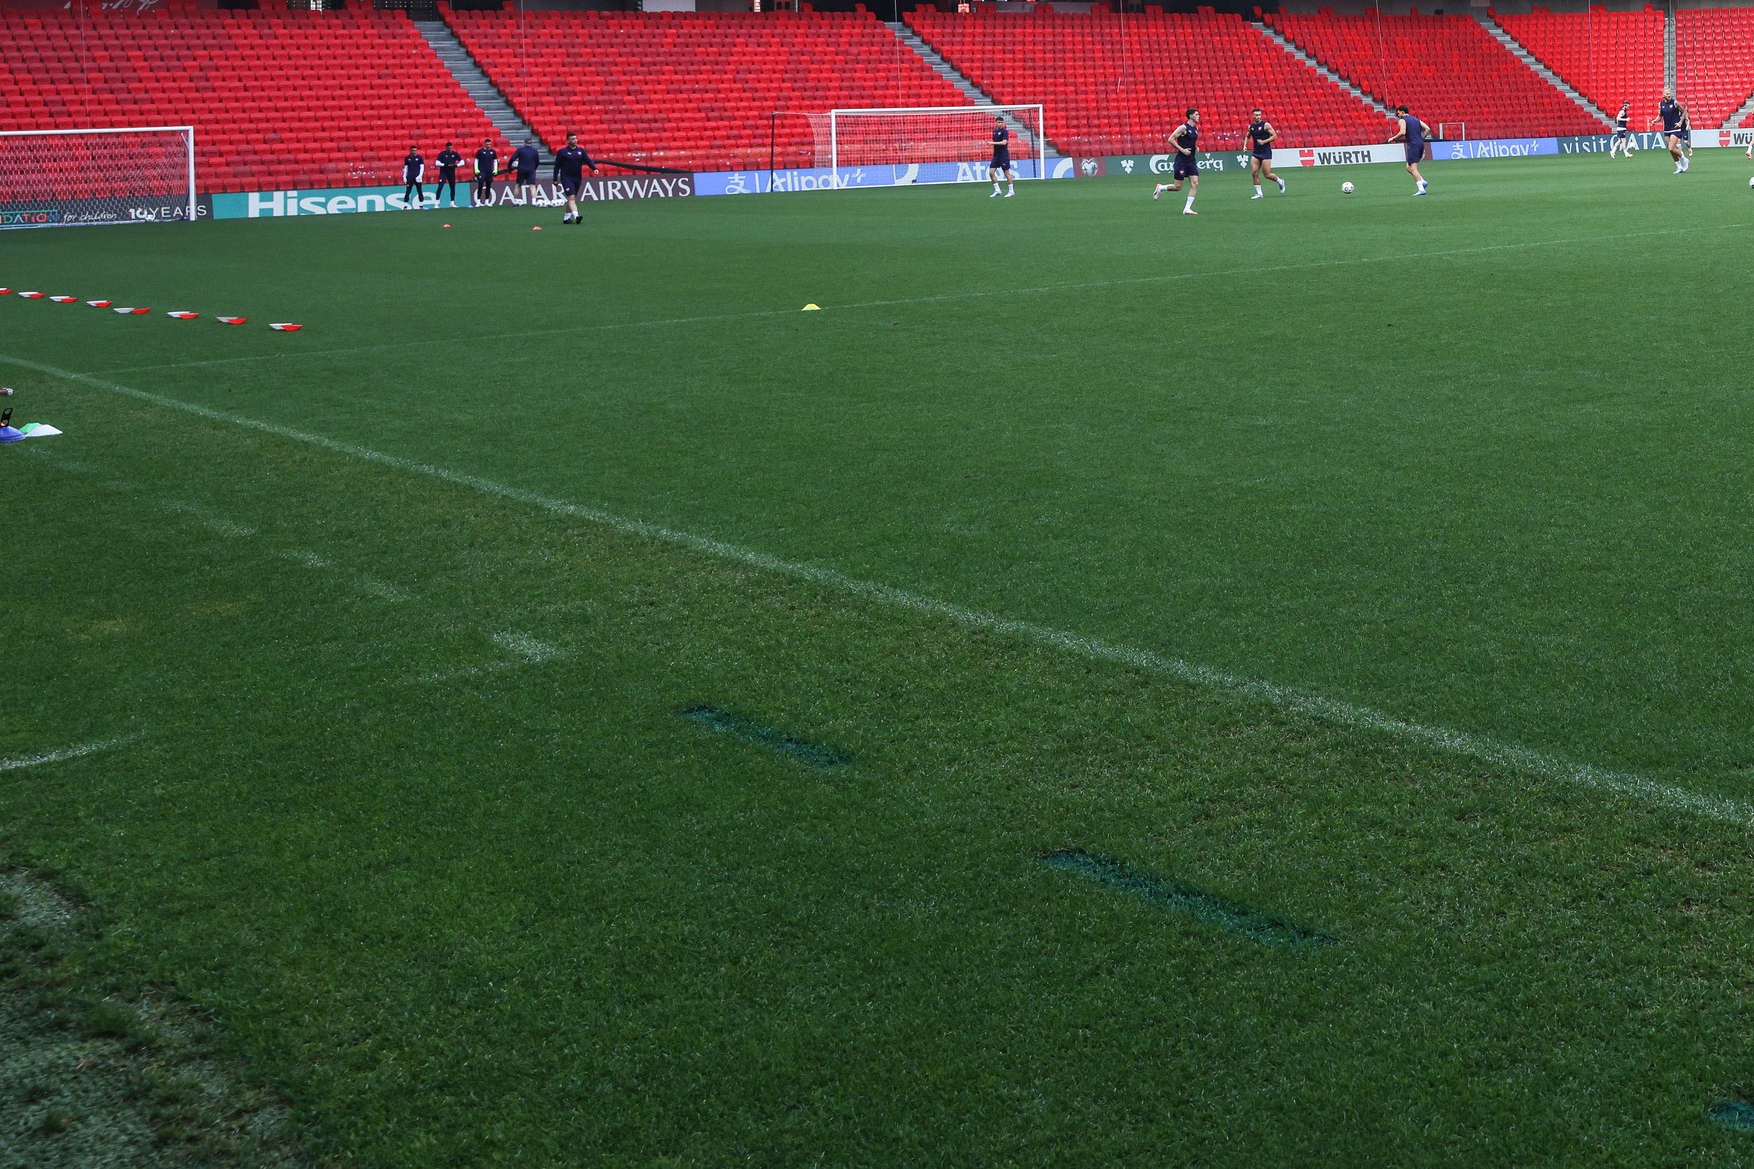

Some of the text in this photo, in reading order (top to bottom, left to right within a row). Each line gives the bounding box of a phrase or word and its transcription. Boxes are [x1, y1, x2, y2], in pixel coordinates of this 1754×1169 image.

[580, 177, 691, 202] AIRWAYS
[247, 190, 439, 219] Hisense
[63, 212, 77, 224] for
